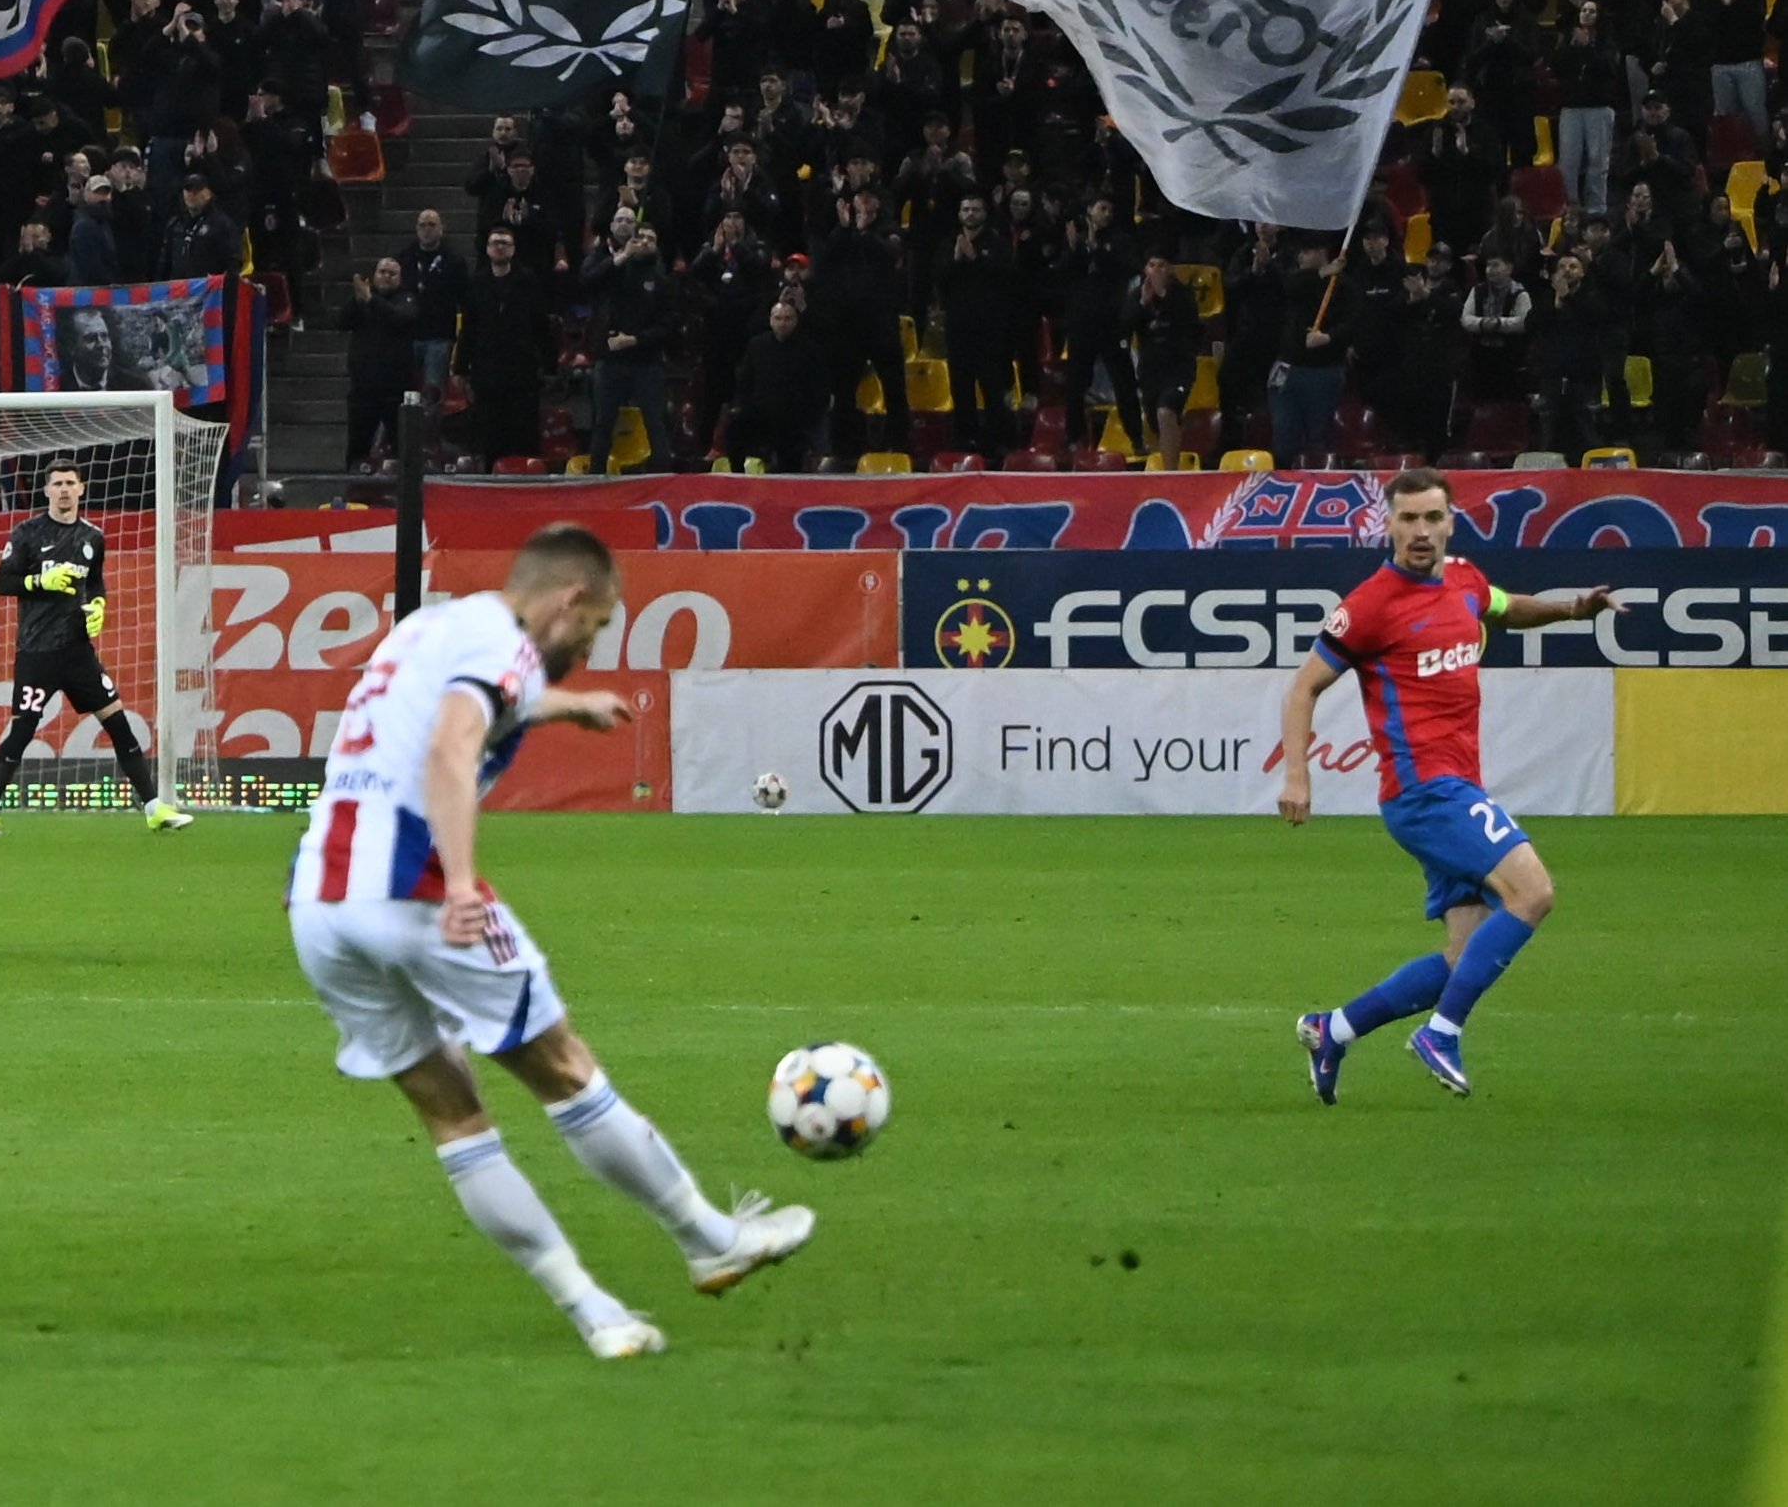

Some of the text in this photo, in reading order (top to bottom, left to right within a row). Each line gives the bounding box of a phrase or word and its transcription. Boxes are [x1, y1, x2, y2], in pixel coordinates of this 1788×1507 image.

[19, 685, 46, 713] 32
[831, 696, 947, 811] MG
[1001, 723, 1112, 773] Find
[1133, 736, 1251, 783] your
